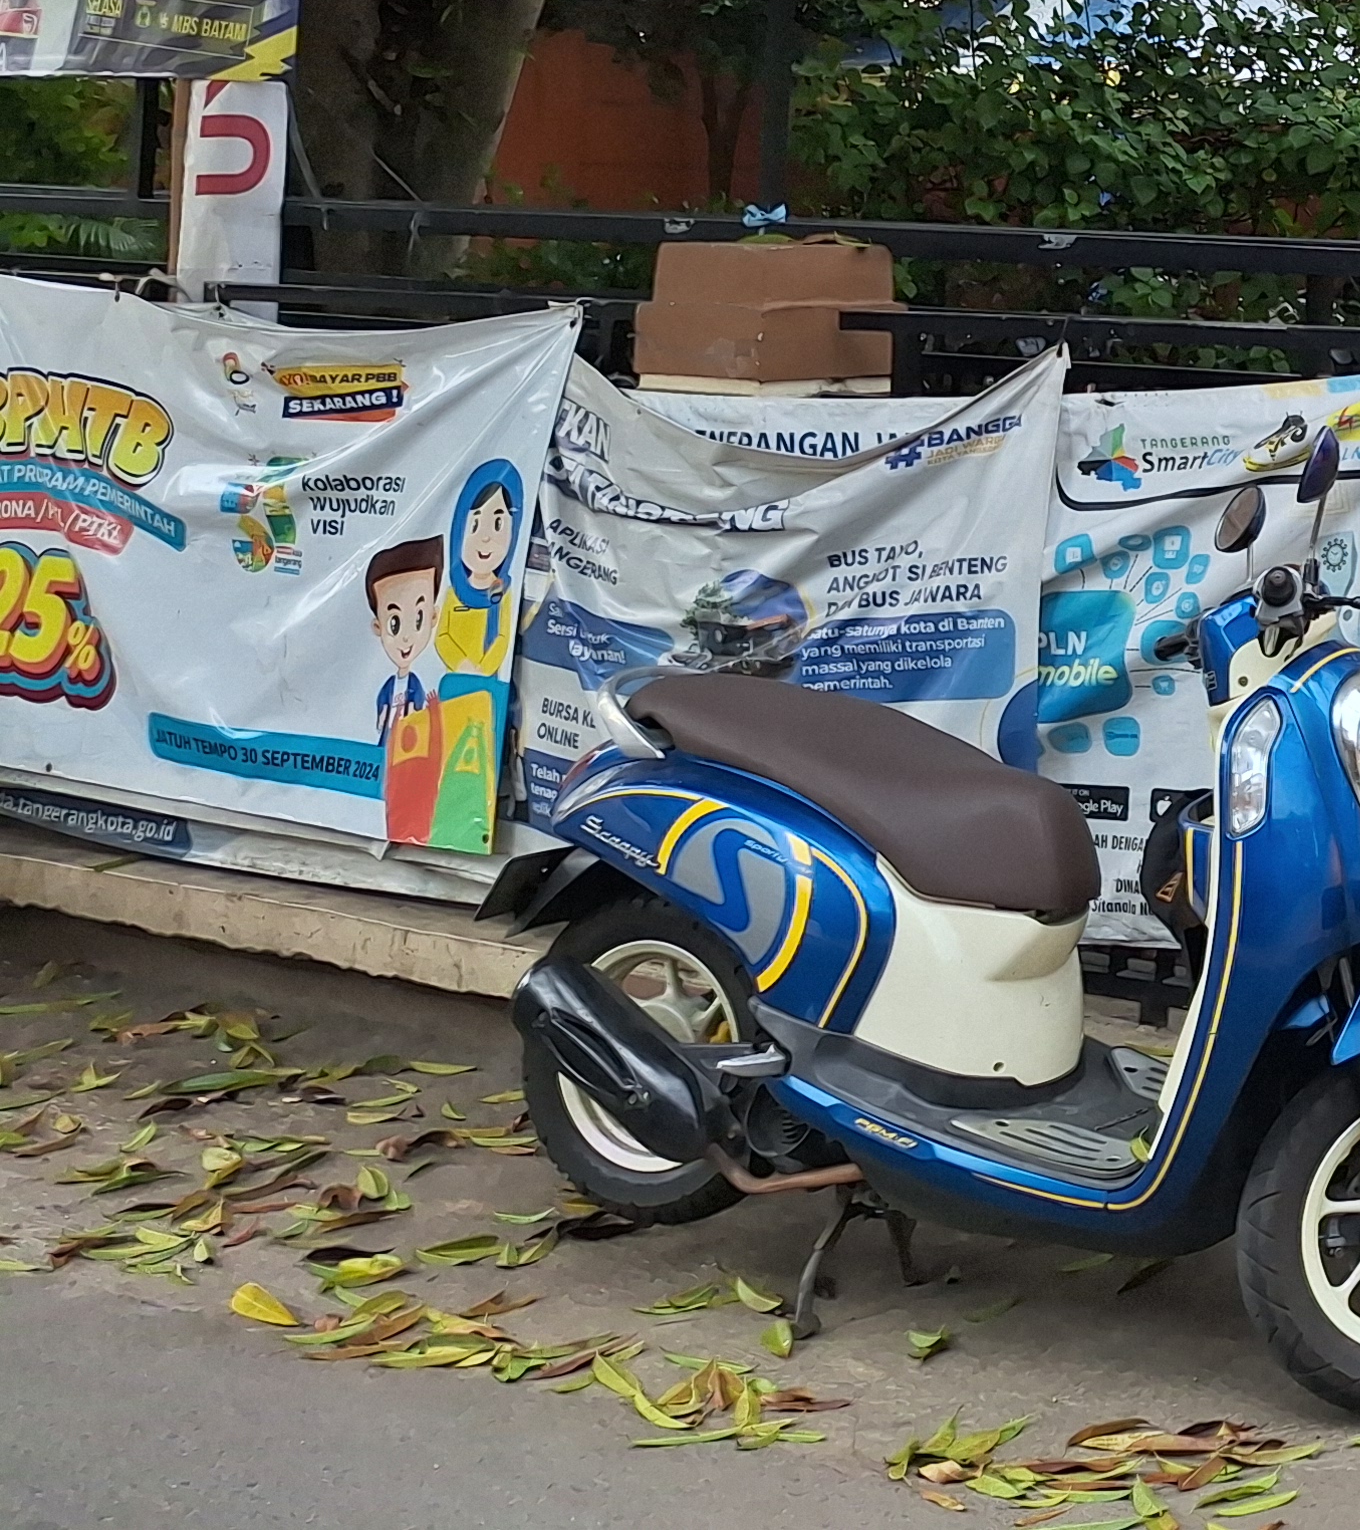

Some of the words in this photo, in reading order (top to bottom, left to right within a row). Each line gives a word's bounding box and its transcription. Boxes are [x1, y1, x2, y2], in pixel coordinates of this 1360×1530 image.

[201, 19, 248, 40] BATAM
[365, 372, 397, 384] PBB
[288, 392, 387, 414] SEKARANG
[0, 370, 172, 480] PHTB
[963, 435, 1005, 451] WARG
[1140, 435, 1230, 449] TANGERANG
[302, 474, 406, 493] kolaborasi
[83, 479, 176, 537] PEMERINTAH
[309, 494, 396, 518] wujudkan
[546, 518, 610, 554] APLIKASI
[827, 548, 869, 568] BUS
[907, 564, 927, 582] SI
[928, 555, 1008, 580] BENTENG
[857, 590, 901, 609] BUS
[903, 583, 982, 607] JAWARA
[579, 629, 610, 645] utuk
[900, 618, 935, 635] kota
[938, 617, 954, 631] di
[957, 617, 1005, 630] Banten
[801, 644, 842, 661] yang
[844, 639, 902, 655] memiliki
[906, 634, 986, 653] transportasi
[1038, 631, 1087, 656] PLN
[801, 659, 858, 676] massal
[859, 660, 892, 675] yang
[894, 656, 952, 672] dikelola
[1038, 657, 1118, 687] mobile
[541, 698, 579, 725] BURSA
[537, 722, 579, 749] ONLINE
[156, 728, 191, 751] JATUH
[194, 738, 237, 761] TEMPO
[241, 747, 258, 764] 30
[261, 749, 351, 777] SEPTEMBER
[352, 760, 380, 782] 2024
[530, 763, 560, 783] Telah
[1100, 800, 1124, 816] Play
[1111, 835, 1149, 852] DENGA
